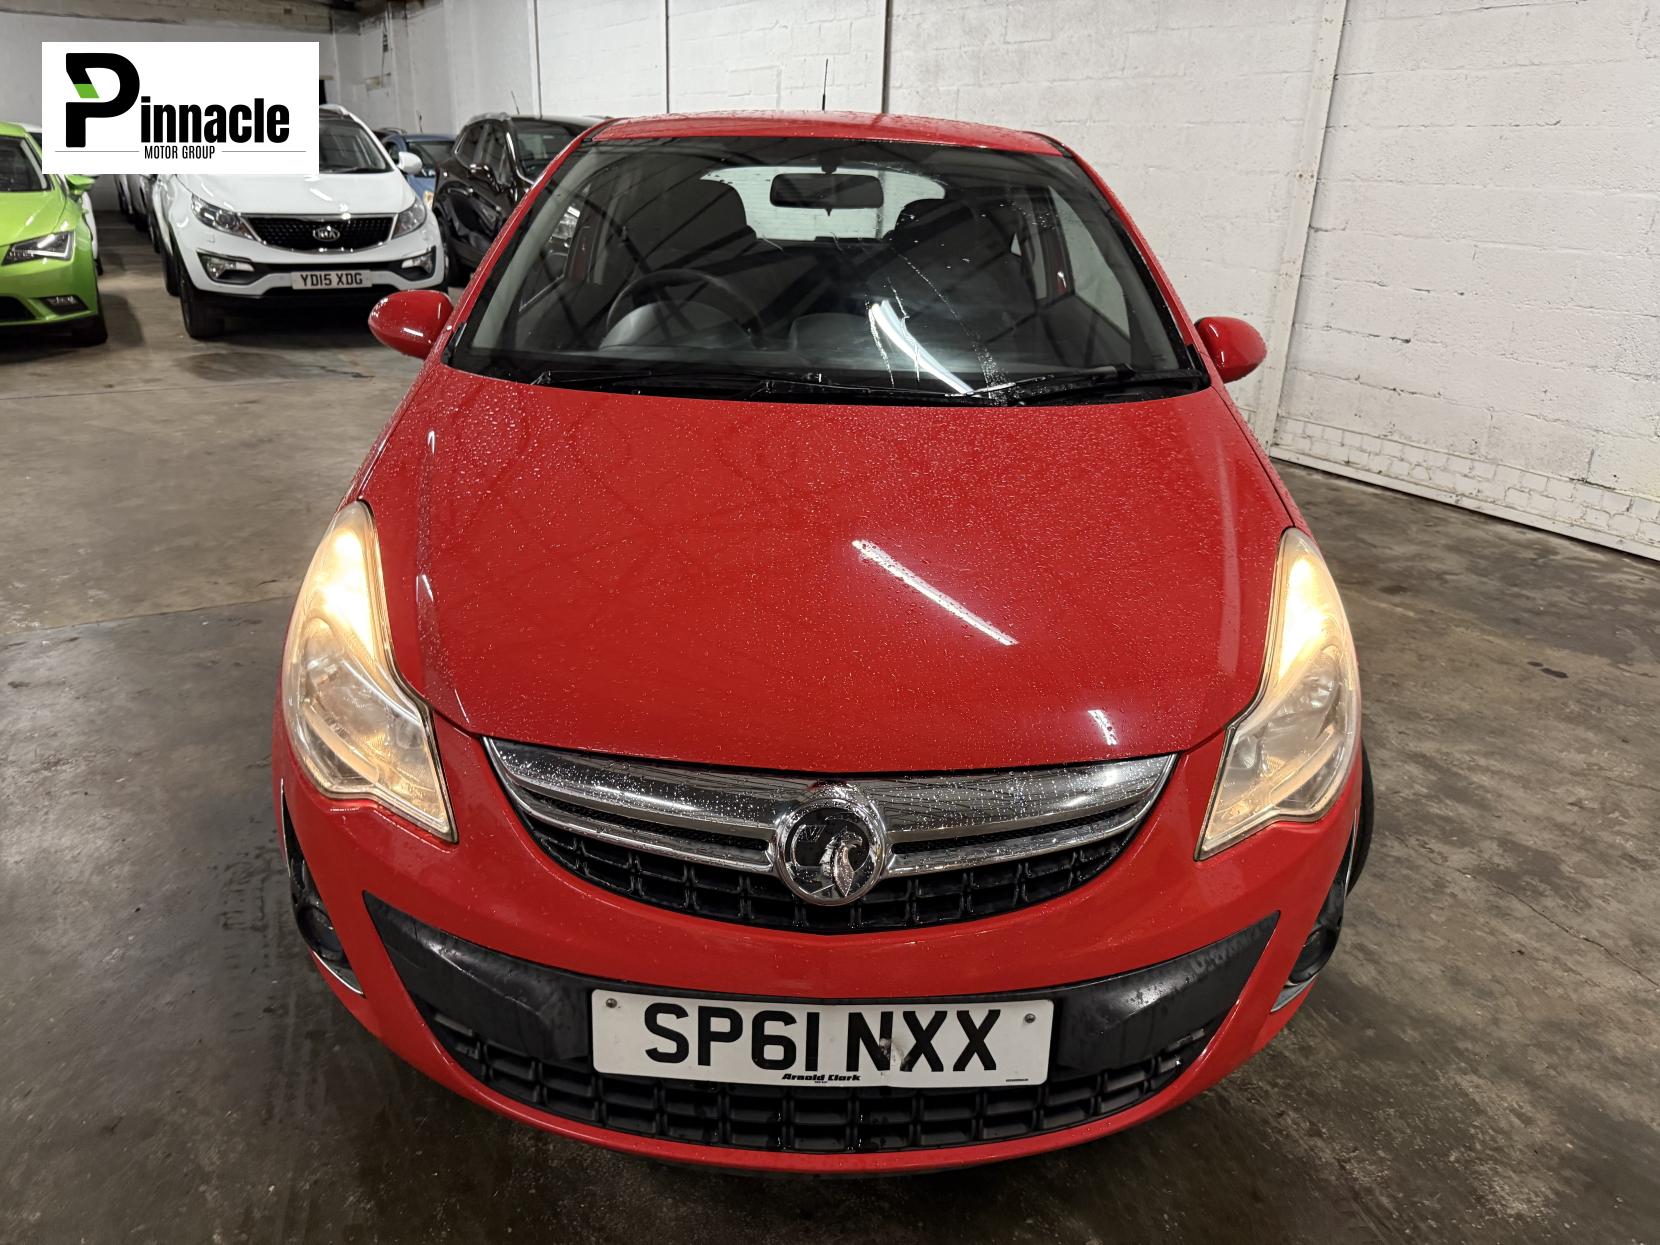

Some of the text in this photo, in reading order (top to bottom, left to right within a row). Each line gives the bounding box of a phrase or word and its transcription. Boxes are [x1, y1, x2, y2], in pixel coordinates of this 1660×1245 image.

[300, 272, 363, 287] YD15 XDG
[644, 1002, 1002, 1073] SP61 NXX
[781, 1073, 861, 1081] Arnold Clark
